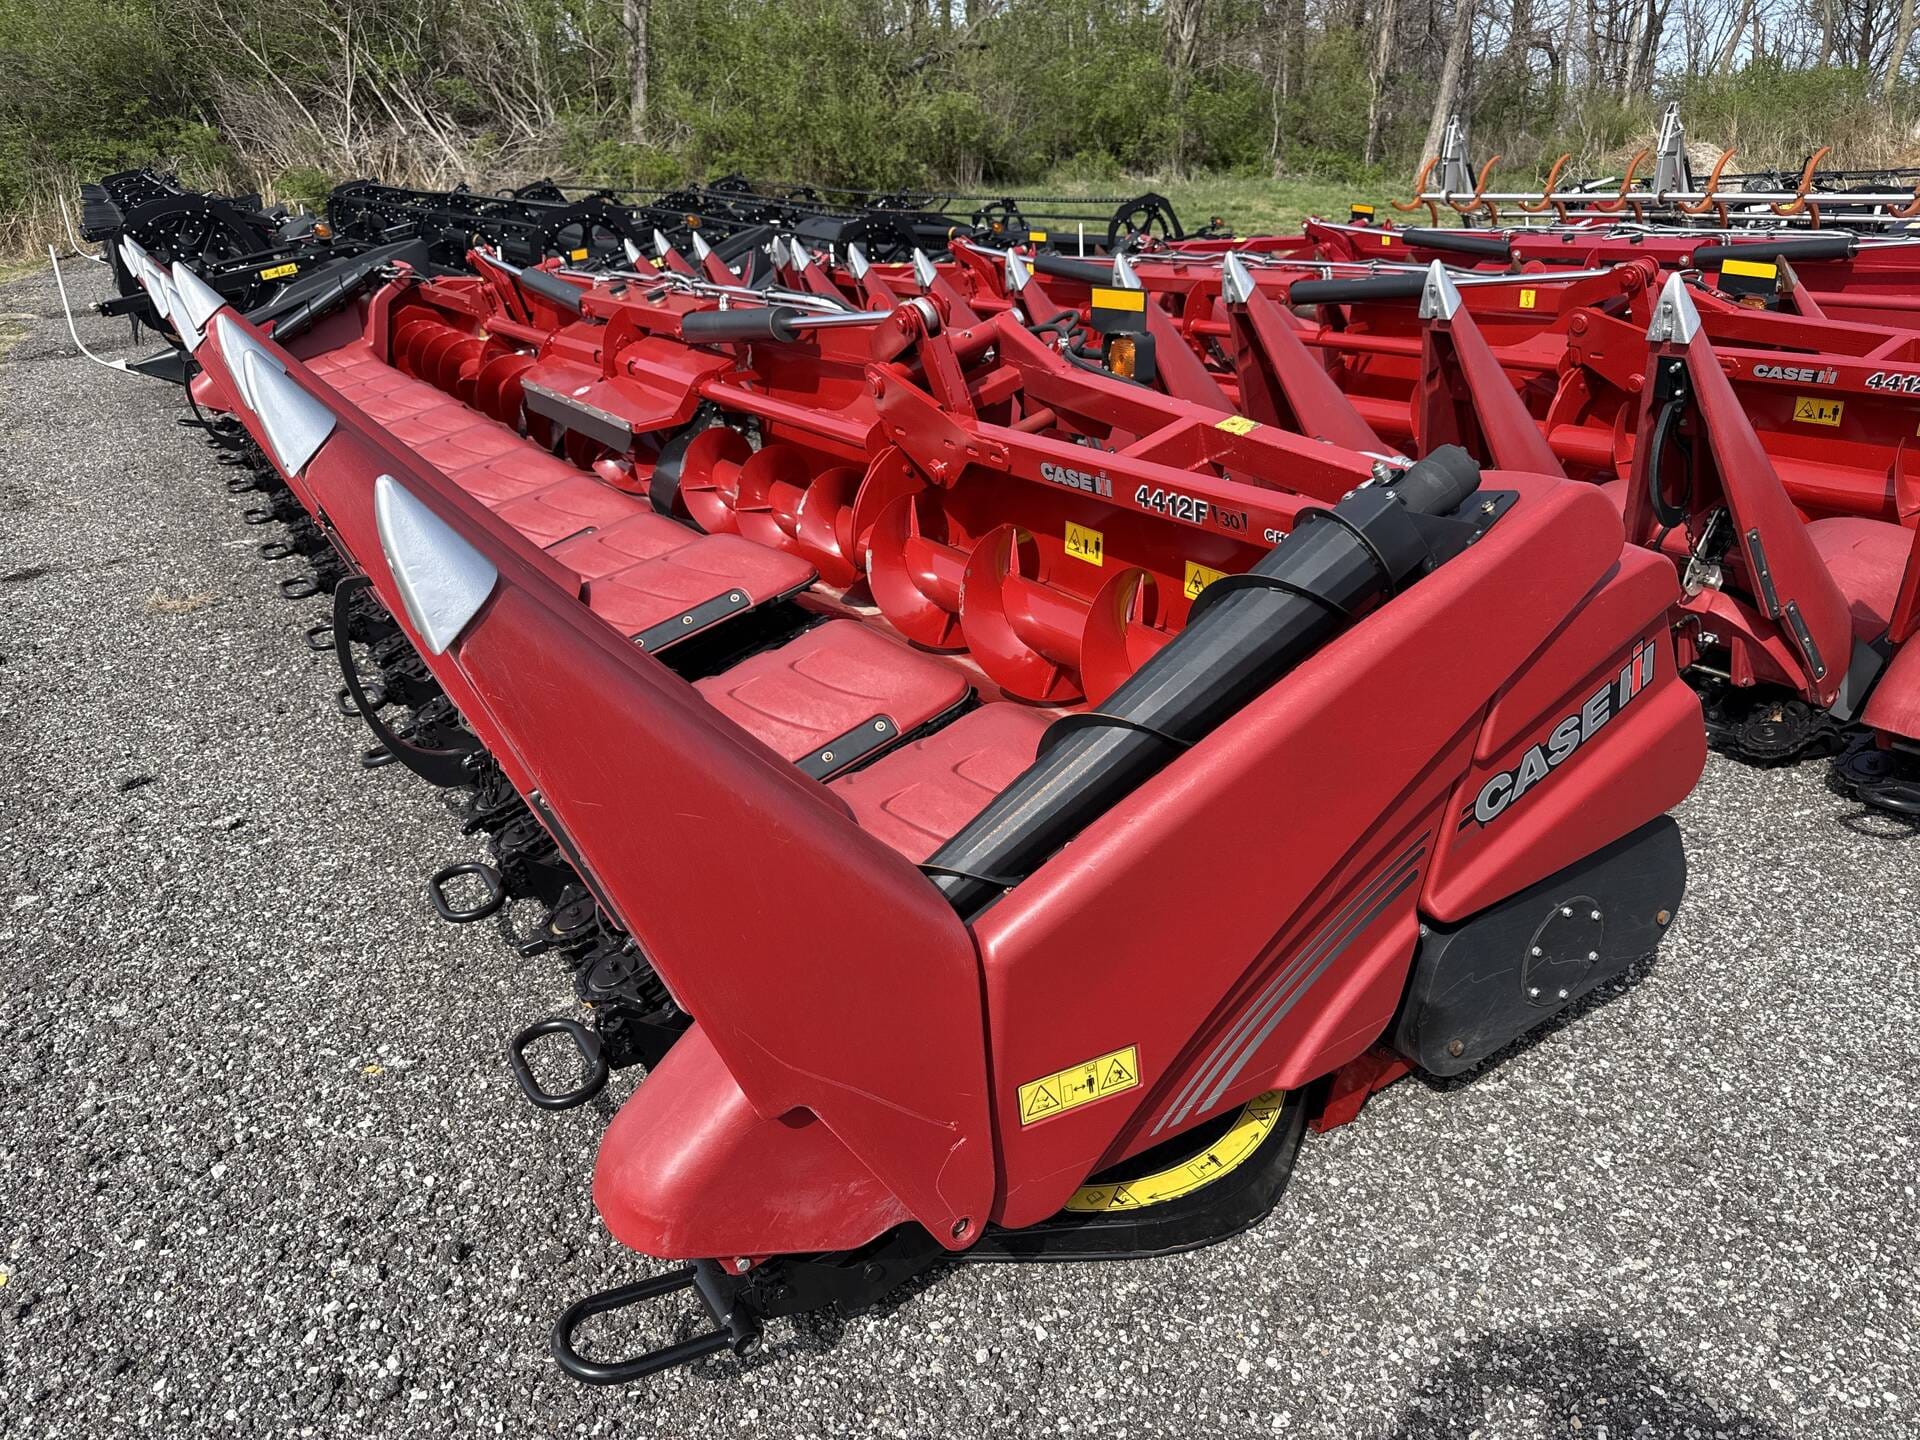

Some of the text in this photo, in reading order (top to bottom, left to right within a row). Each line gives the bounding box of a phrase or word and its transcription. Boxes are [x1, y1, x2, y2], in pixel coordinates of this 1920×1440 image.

[1752, 364, 1814, 383] CASE
[1040, 462, 1093, 492] CASE
[1135, 485, 1208, 525] 4412F
[1220, 511, 1240, 530] 30
[1263, 528, 1290, 544] CH
[1474, 680, 1613, 823] CASE
